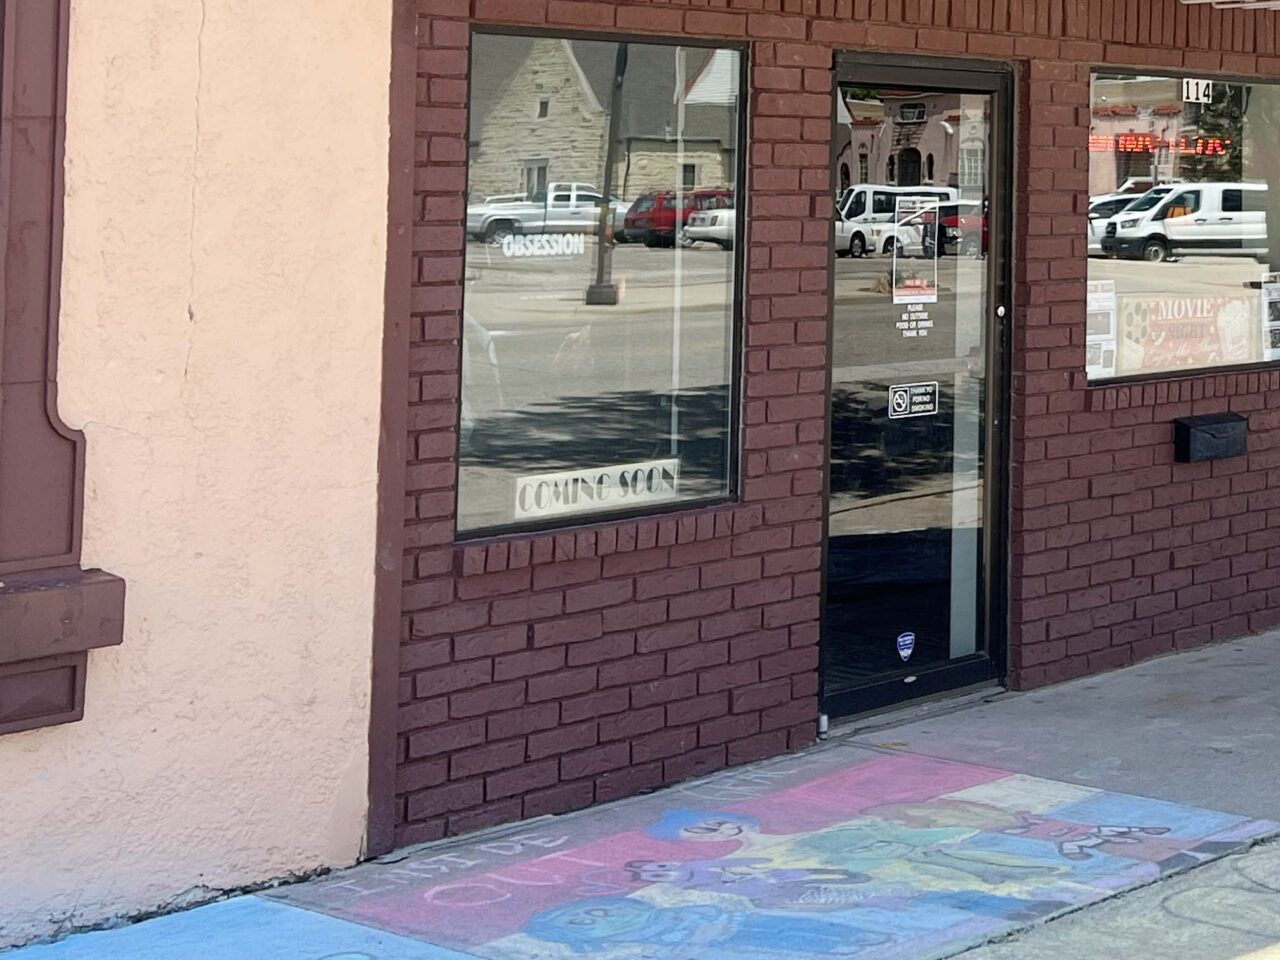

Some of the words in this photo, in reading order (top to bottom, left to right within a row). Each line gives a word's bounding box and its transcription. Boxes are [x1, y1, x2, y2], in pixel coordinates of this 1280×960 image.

[1185, 80, 1211, 102] 114
[502, 233, 585, 257] OBSESSION
[1156, 297, 1214, 320] MOVIE
[518, 473, 611, 512] COMING
[619, 465, 675, 498] SOON
